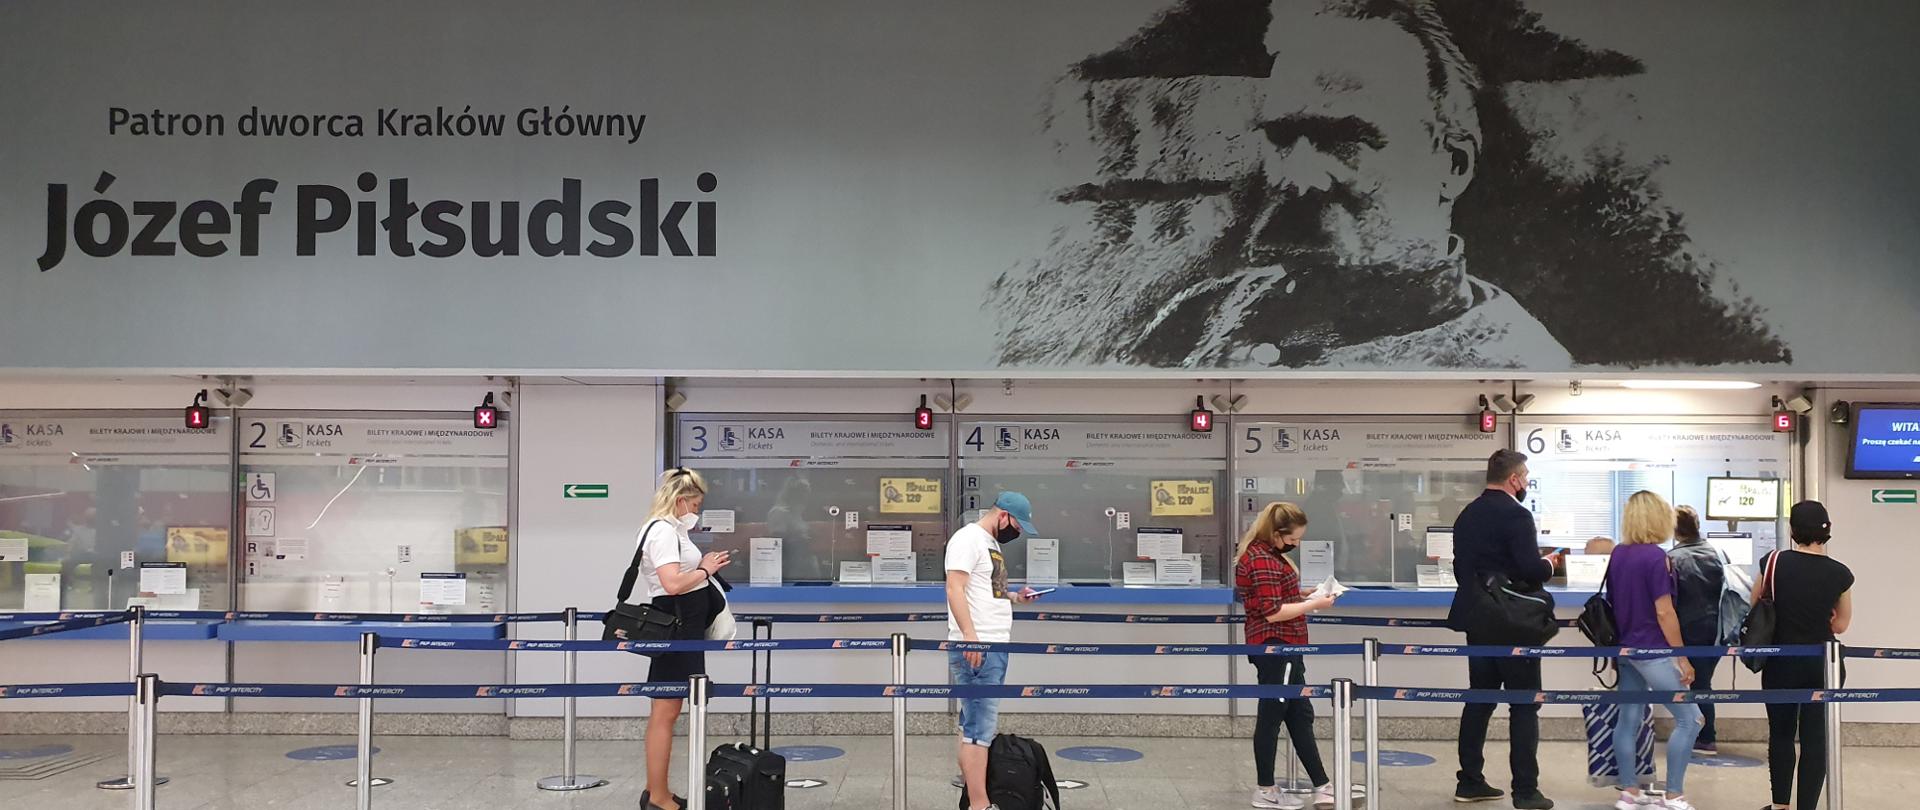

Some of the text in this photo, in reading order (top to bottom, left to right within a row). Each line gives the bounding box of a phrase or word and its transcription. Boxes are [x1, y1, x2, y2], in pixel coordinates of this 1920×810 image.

[109, 104, 647, 145] Patron dworca Kraków Główny
[36, 170, 718, 273] Józef Piłsudski
[193, 412, 201, 424] 1
[920, 413, 928, 425] 3
[1196, 415, 1206, 427] 4
[1485, 416, 1493, 428] 5
[1778, 415, 1789, 427] 6
[26, 424, 64, 436] KASA
[306, 424, 344, 436] KASA
[748, 427, 785, 439] KASA
[1892, 422, 1920, 432] WITA
[249, 422, 267, 448] 2
[690, 426, 708, 452] 3
[965, 426, 985, 452] 4
[1024, 428, 1060, 440] KASA
[1245, 427, 1262, 453] 5
[1303, 429, 1341, 441] KASA
[1585, 429, 1622, 441] KASA
[306, 438, 331, 447] tickets
[748, 441, 773, 450] tickets
[1024, 442, 1049, 451] tickets
[1526, 427, 1546, 454] 6
[1862, 438, 1886, 447] Proszę
[1303, 443, 1328, 452] tickets
[968, 476, 977, 487] R
[1245, 478, 1255, 489] R
[1529, 479, 1538, 490] R
[1177, 495, 1194, 505] 120
[1739, 496, 1754, 506] 120
[248, 542, 257, 553] R
